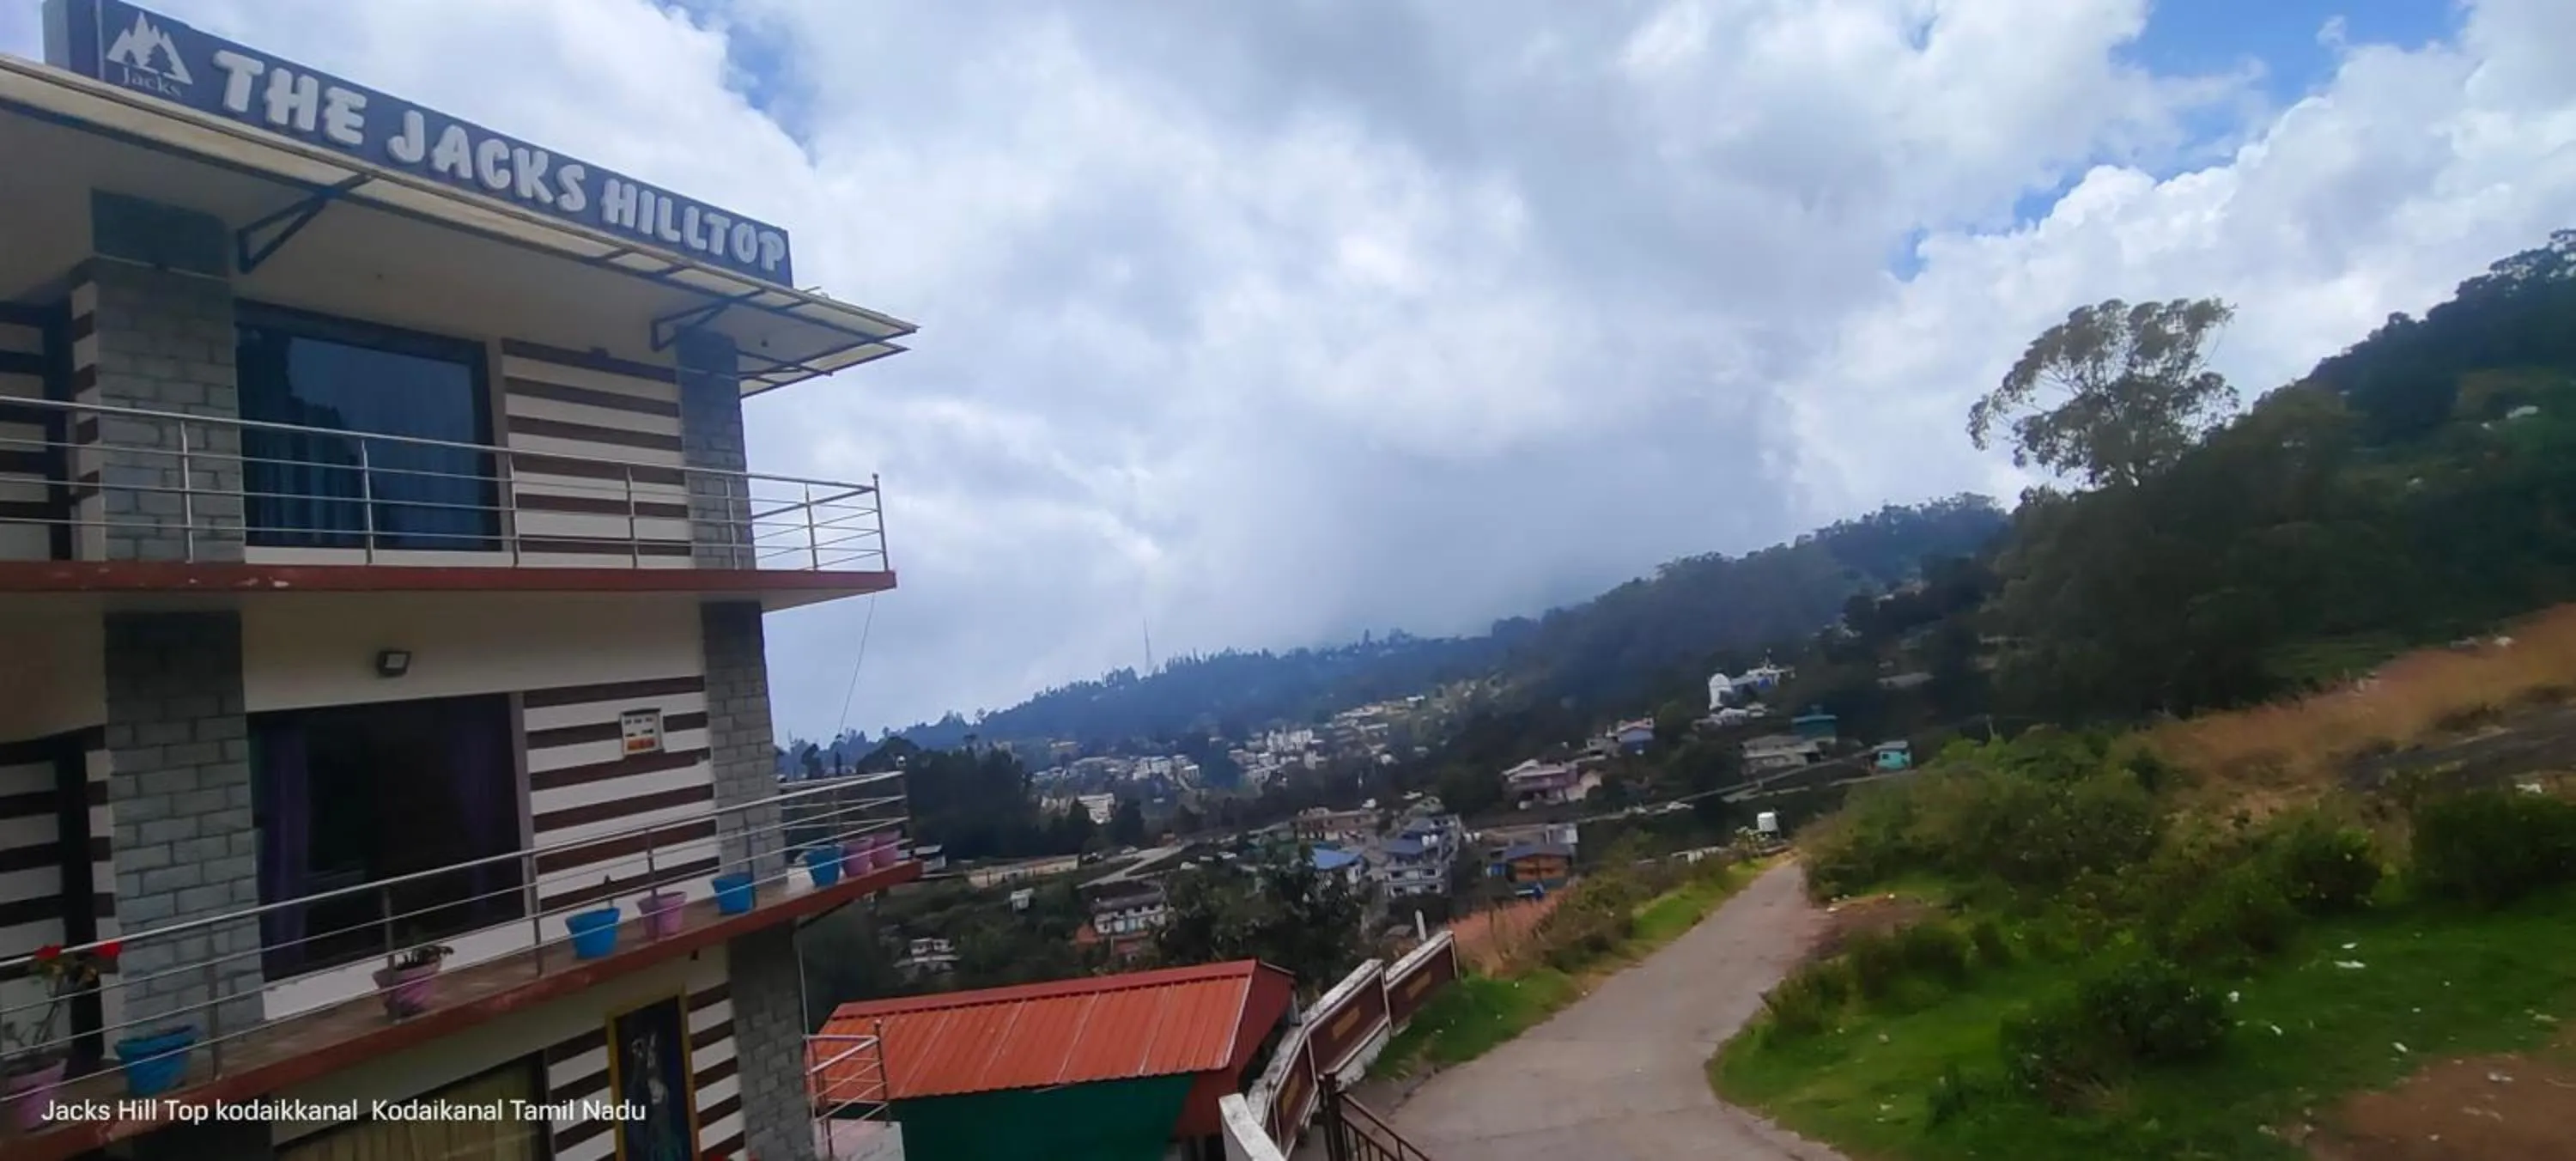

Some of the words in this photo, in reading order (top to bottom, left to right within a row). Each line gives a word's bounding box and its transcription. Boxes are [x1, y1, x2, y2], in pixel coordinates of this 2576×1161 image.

[122, 65, 182, 98] Jacks
[213, 49, 368, 146] THE
[386, 109, 588, 213] JACKS
[601, 178, 787, 271] HILLTOP
